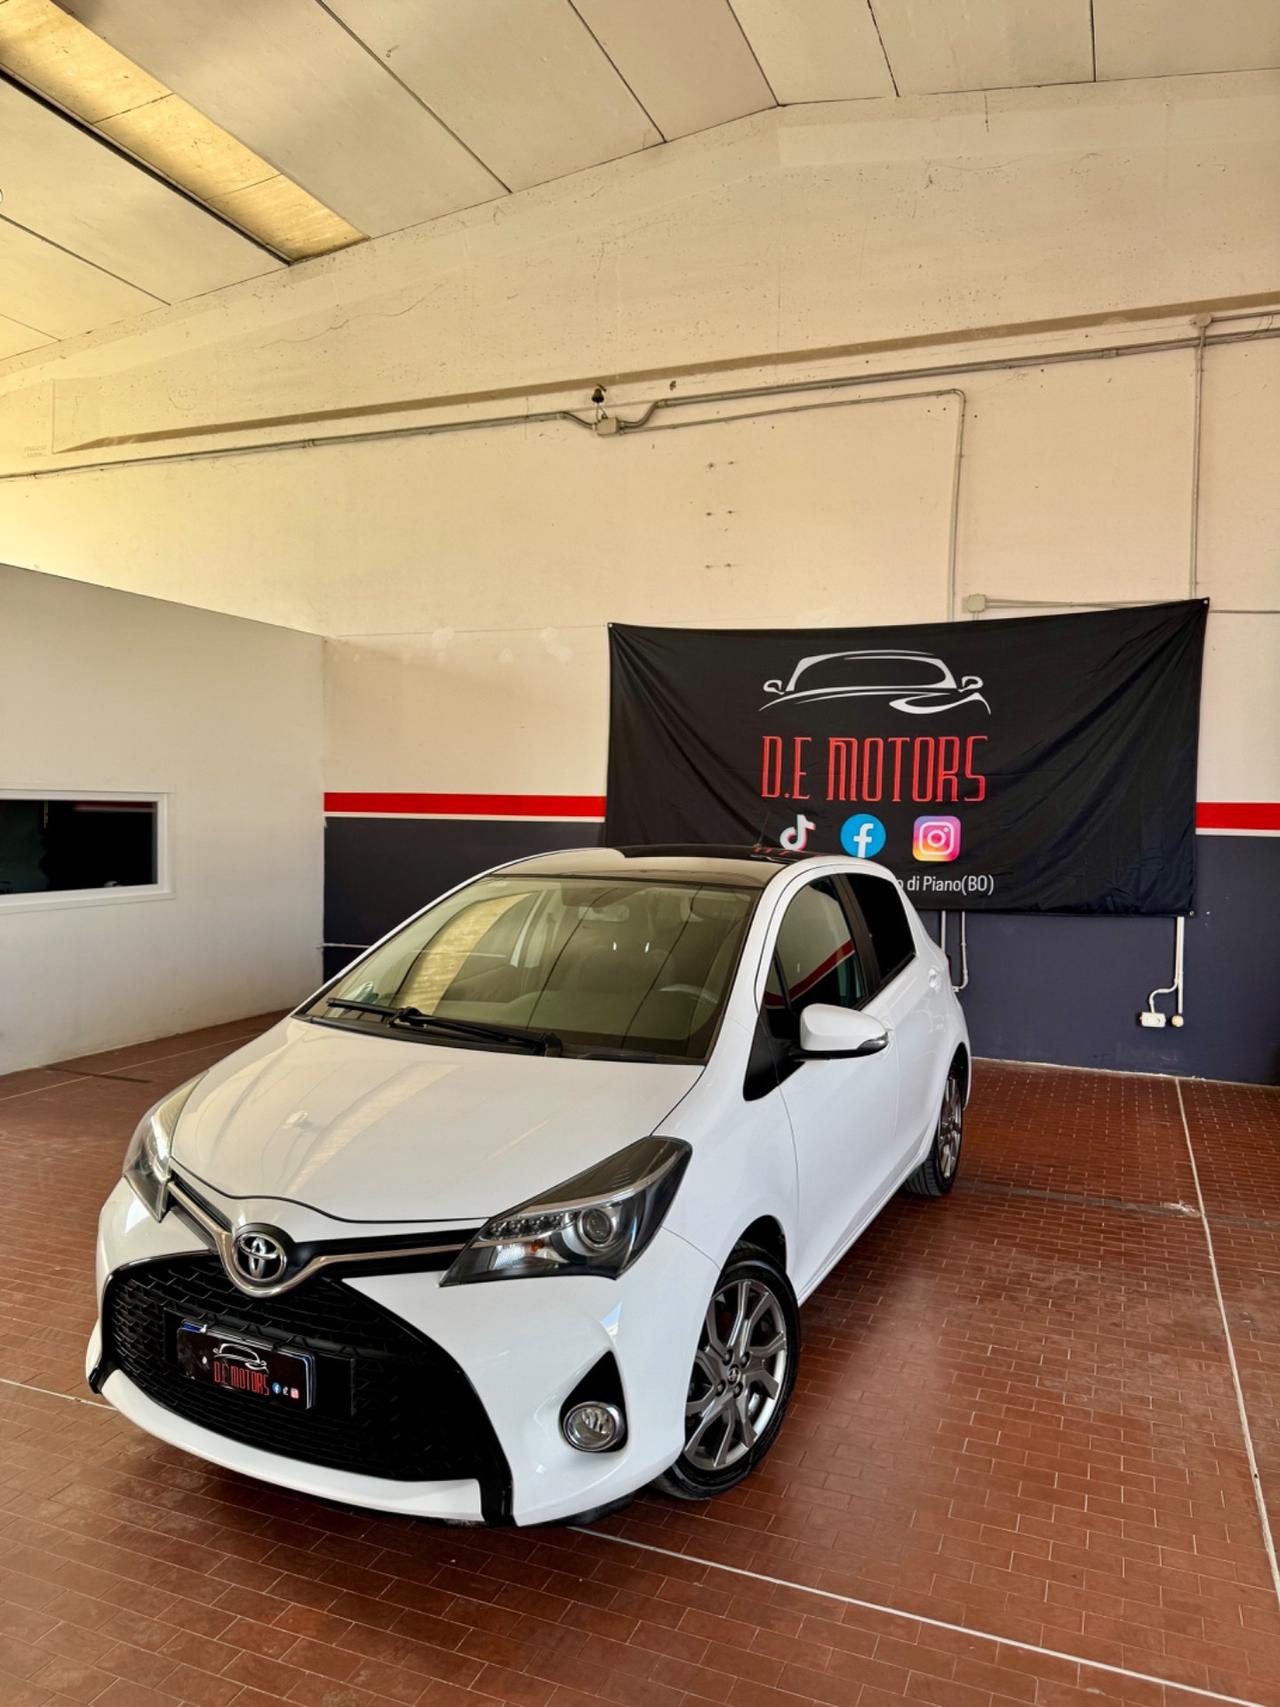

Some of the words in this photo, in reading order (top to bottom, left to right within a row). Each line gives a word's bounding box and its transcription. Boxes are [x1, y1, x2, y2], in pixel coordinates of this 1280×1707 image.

[761, 735, 812, 800] D.E
[826, 735, 988, 802] MOTORS
[907, 875, 920, 892] di
[922, 874, 994, 896] Piano(BO)
[230, 1365, 270, 1396] MOTORS
